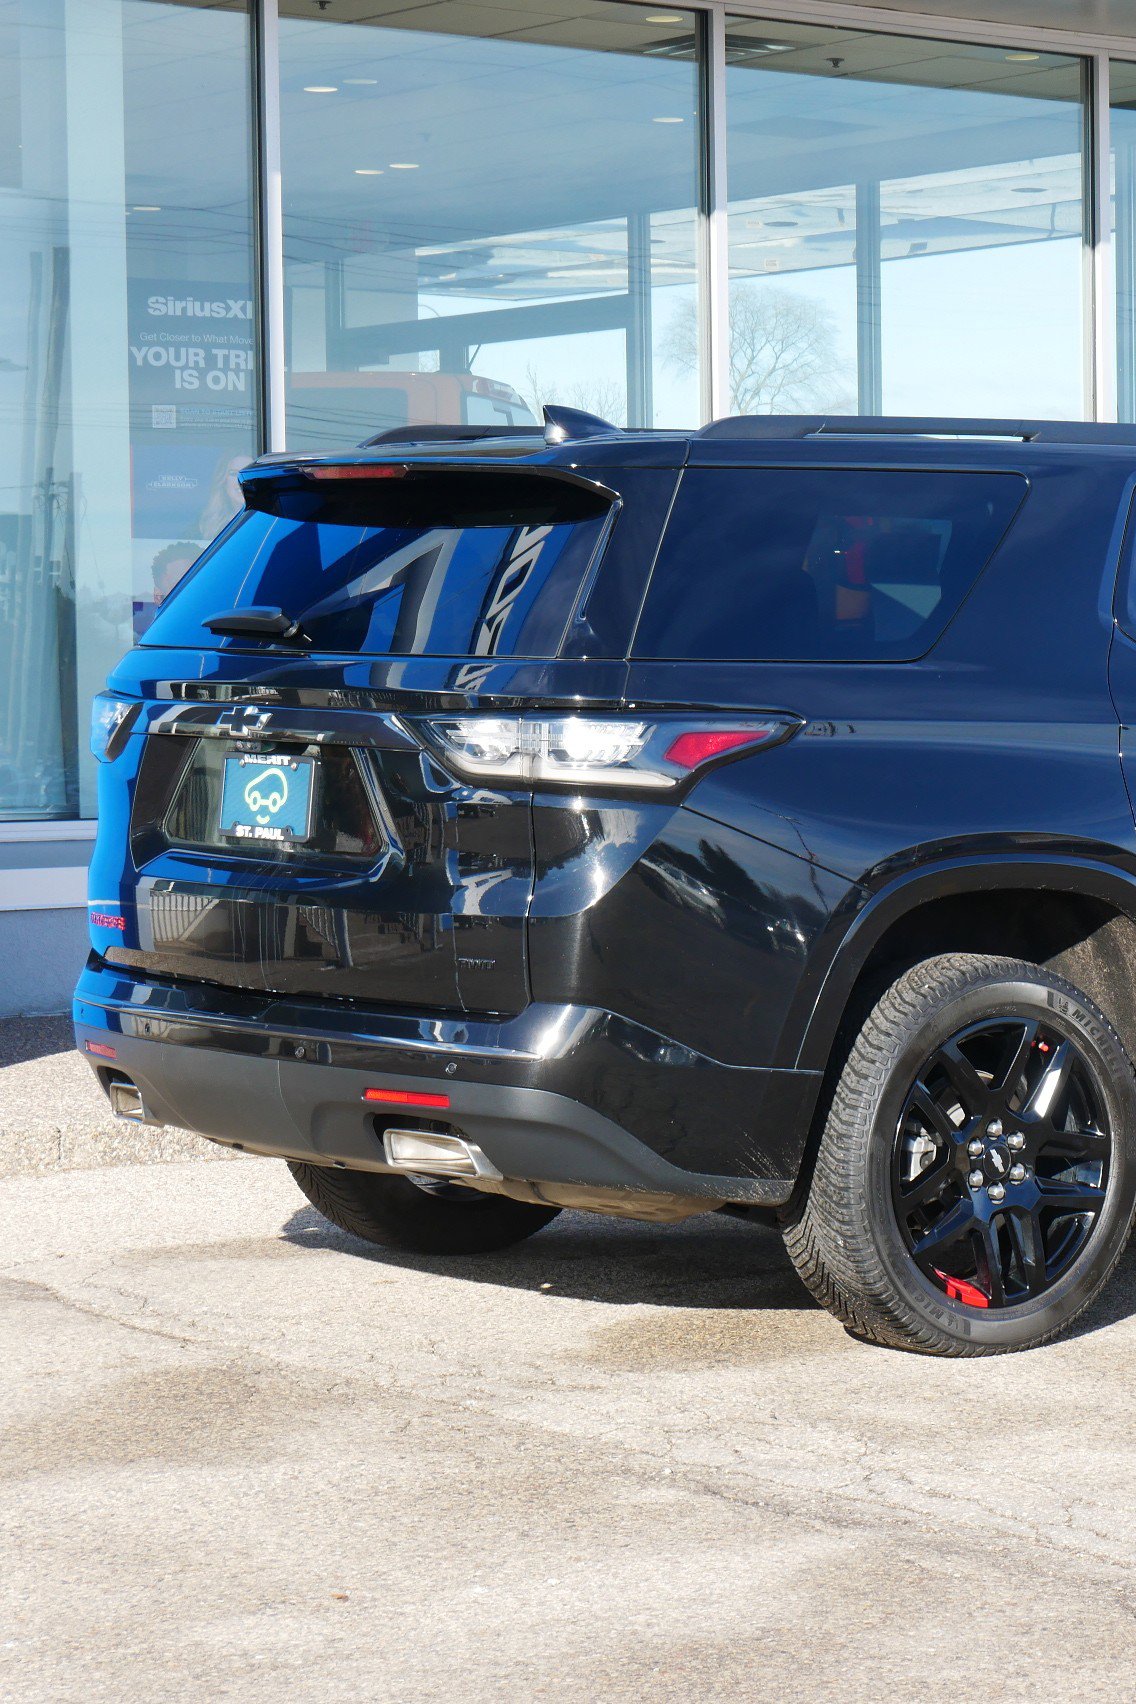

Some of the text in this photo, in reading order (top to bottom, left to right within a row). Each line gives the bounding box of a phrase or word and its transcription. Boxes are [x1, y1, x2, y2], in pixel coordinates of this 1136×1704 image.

[140, 332, 157, 341] Get
[160, 332, 189, 342] Closer
[204, 335, 227, 343] What
[230, 335, 254, 344] Move
[130, 347, 254, 370] YOUR TRI
[175, 369, 246, 391] IS ON
[244, 754, 291, 766] MERIT
[236, 825, 285, 840] ST. PAUL
